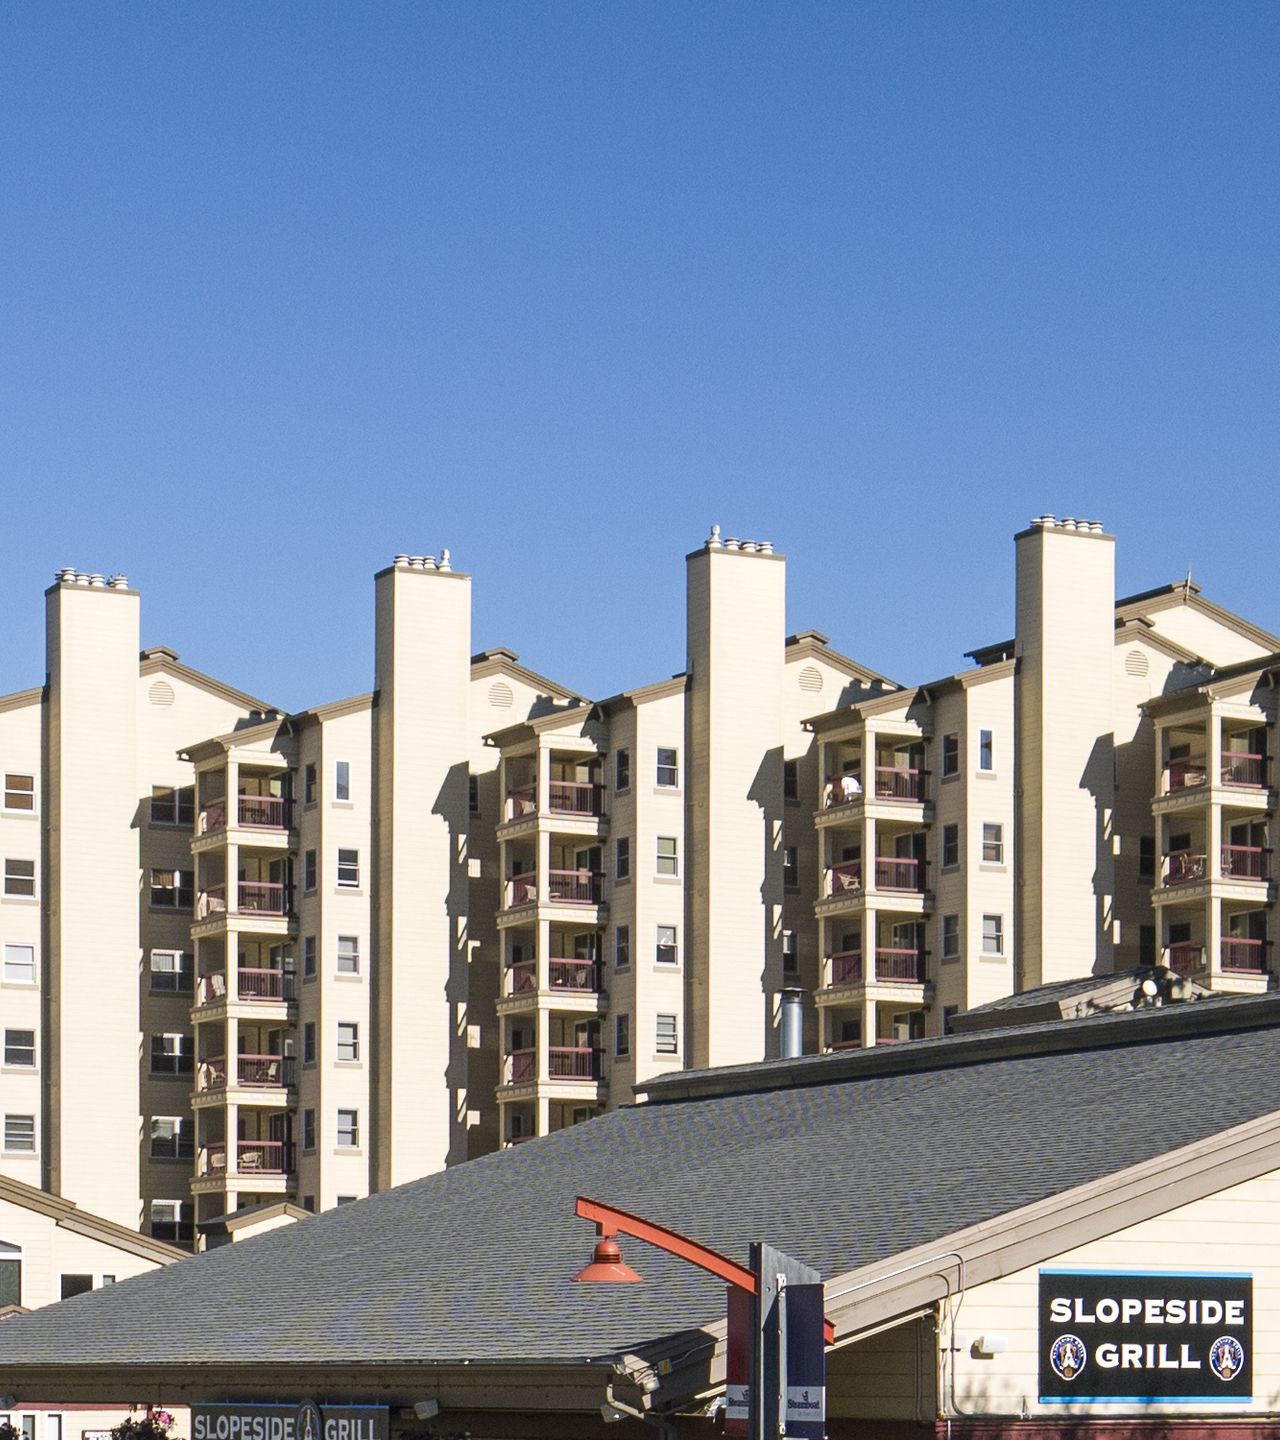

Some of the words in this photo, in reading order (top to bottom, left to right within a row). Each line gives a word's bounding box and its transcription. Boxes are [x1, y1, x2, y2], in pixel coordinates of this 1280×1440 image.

[1049, 1297, 1245, 1326] SLOPESIDE
[1094, 1342, 1202, 1370] GRILL
[787, 1396, 820, 1409] Steamboat
